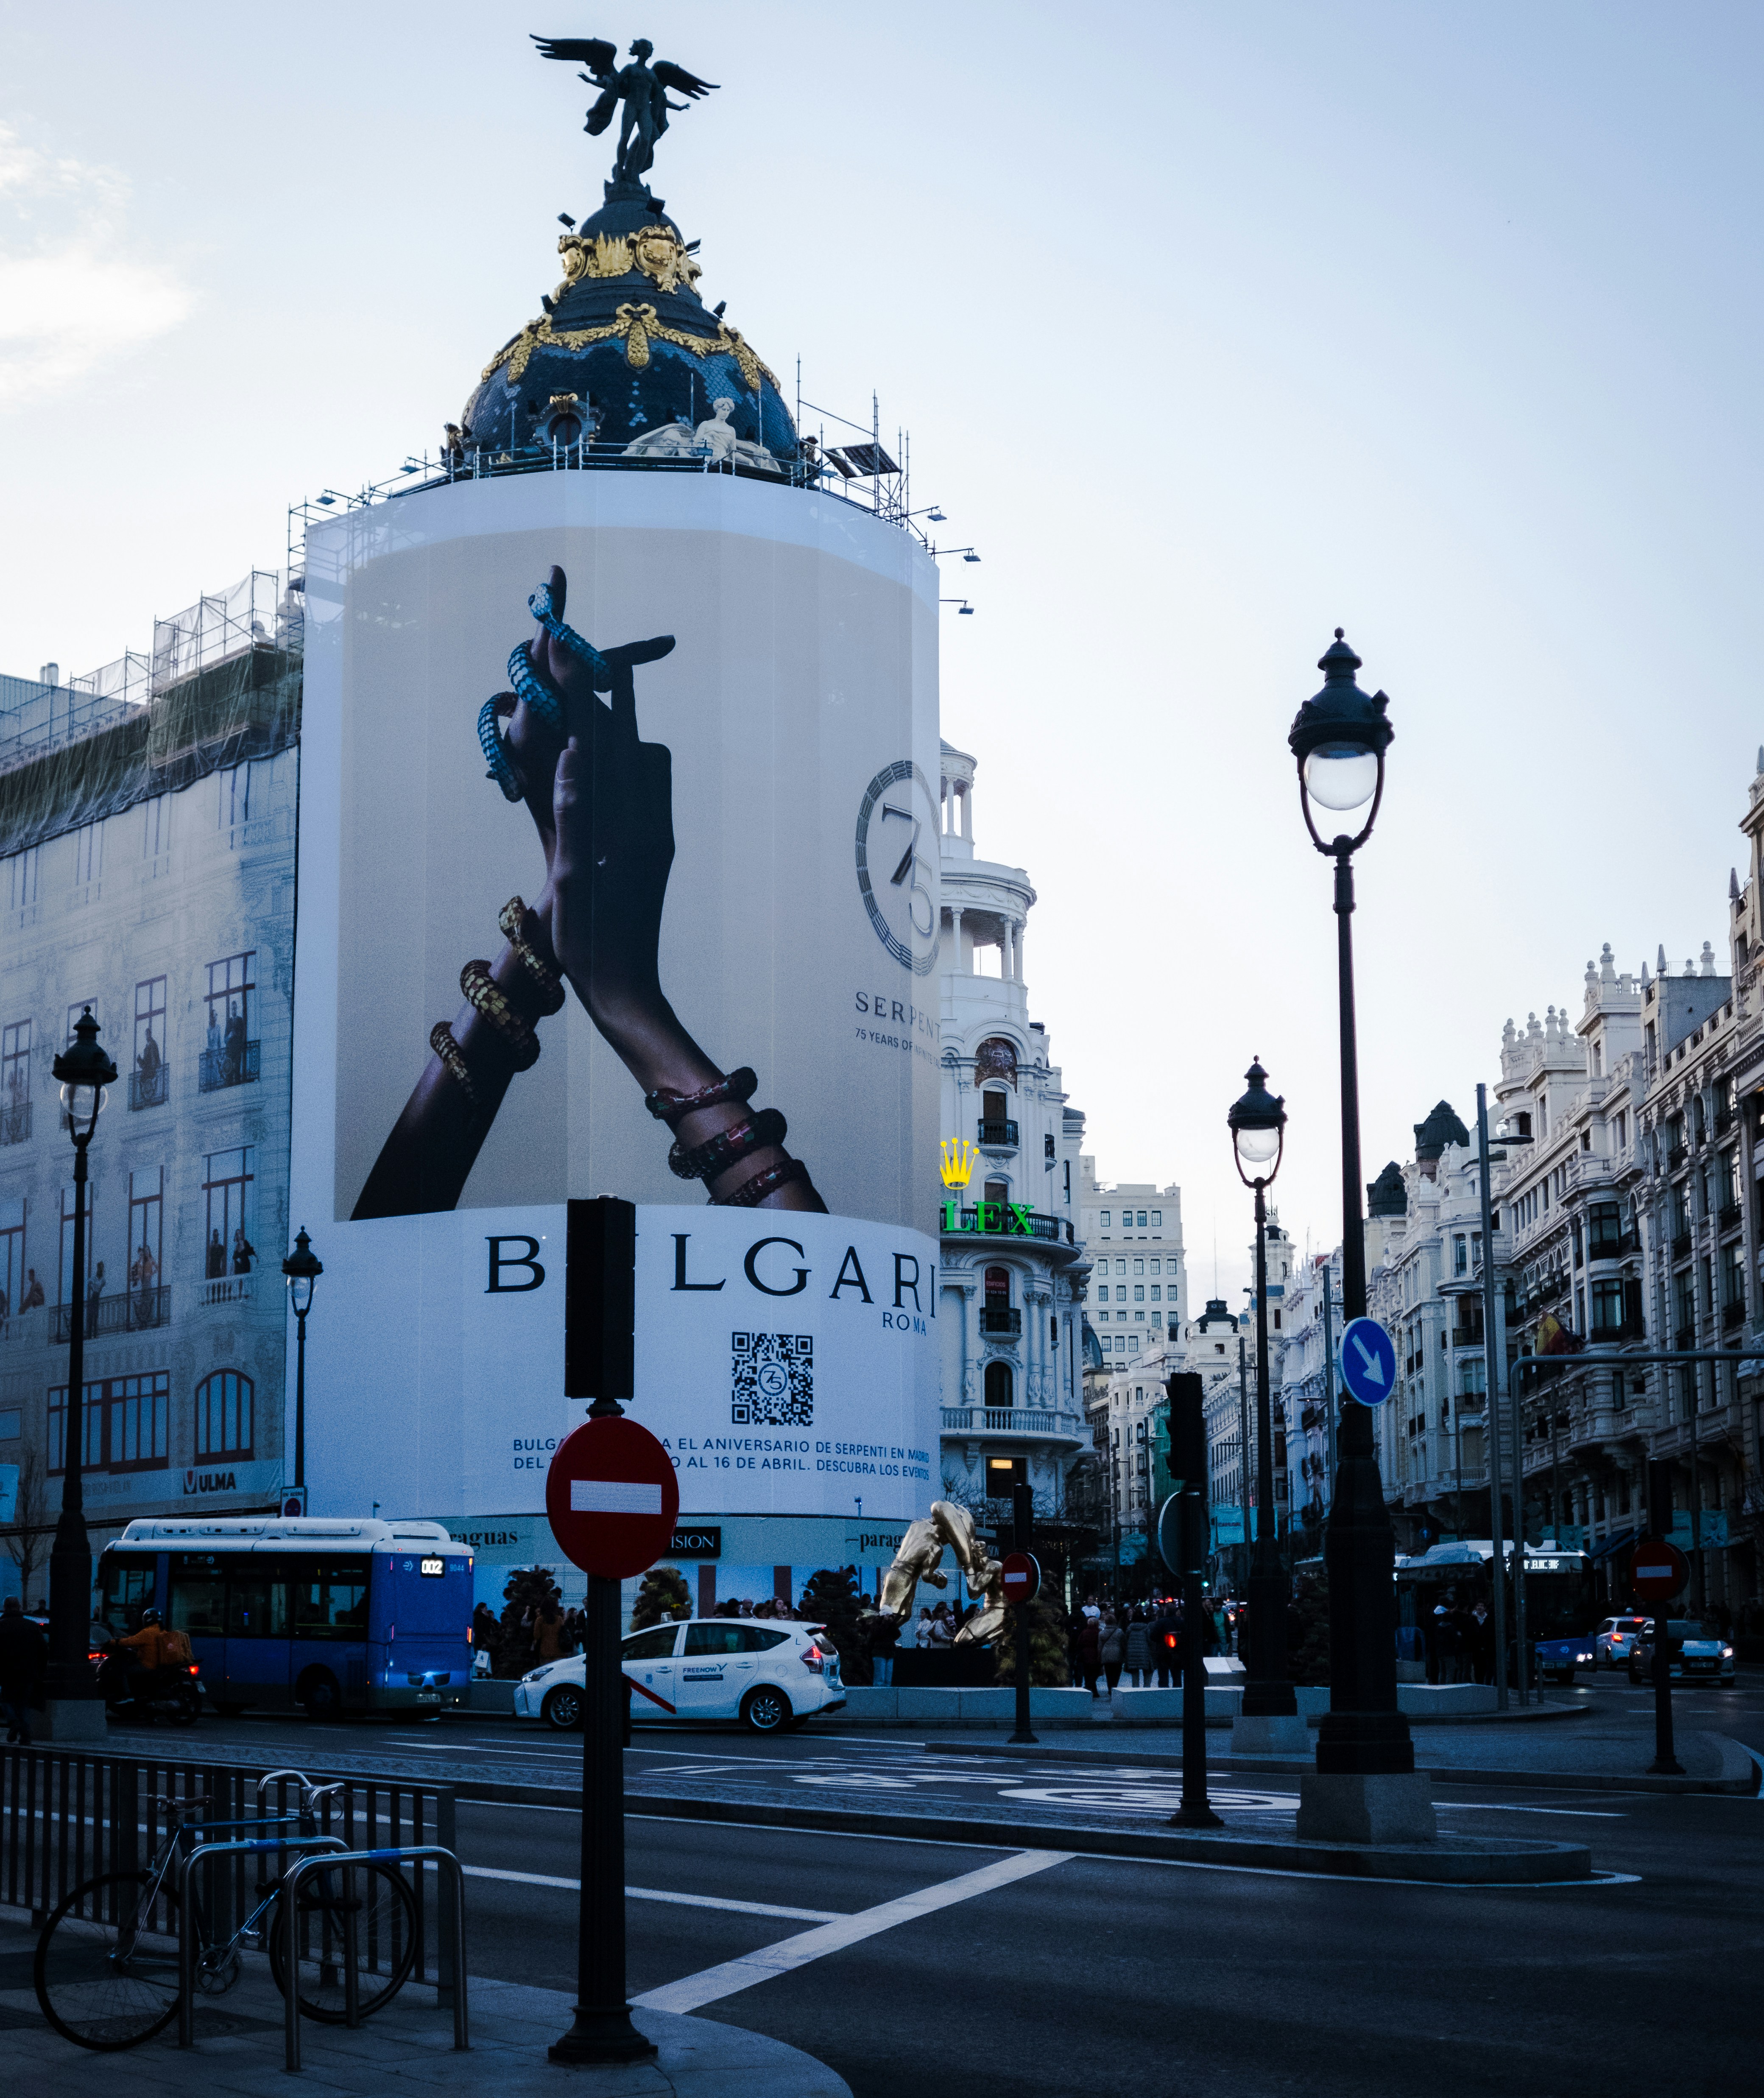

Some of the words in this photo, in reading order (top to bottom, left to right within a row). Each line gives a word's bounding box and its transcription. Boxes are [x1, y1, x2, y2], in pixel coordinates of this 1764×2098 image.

[856, 992, 941, 1043] SERPENT
[856, 1028, 866, 1039] 75
[869, 1031, 899, 1048] YEARS
[902, 1040, 913, 1050] OF
[942, 1201, 1035, 1235] LEX
[484, 1233, 935, 1318] BLGARI
[883, 1312, 927, 1336] ROMA
[514, 1438, 562, 1451] BULG
[678, 1438, 698, 1450] EL
[703, 1439, 809, 1453] ANIVERSARIO
[816, 1442, 831, 1453] DE
[835, 1443, 887, 1458] SERPENTI
[891, 1447, 904, 1459] EN
[514, 1457, 544, 1469] DEL
[687, 1456, 708, 1468] AL
[714, 1456, 730, 1468] 16
[737, 1457, 756, 1469] DE
[762, 1458, 810, 1470] ABRIL.
[817, 1459, 876, 1475] DESCUBRA
[879, 1464, 899, 1476] LOS
[902, 1465, 929, 1481] EVENTOS
[199, 1472, 237, 1493] ULMA
[449, 1531, 518, 1552] raguas
[671, 1535, 714, 1548] ISION
[860, 1534, 904, 1554] parag
[421, 1559, 443, 1574] 002
